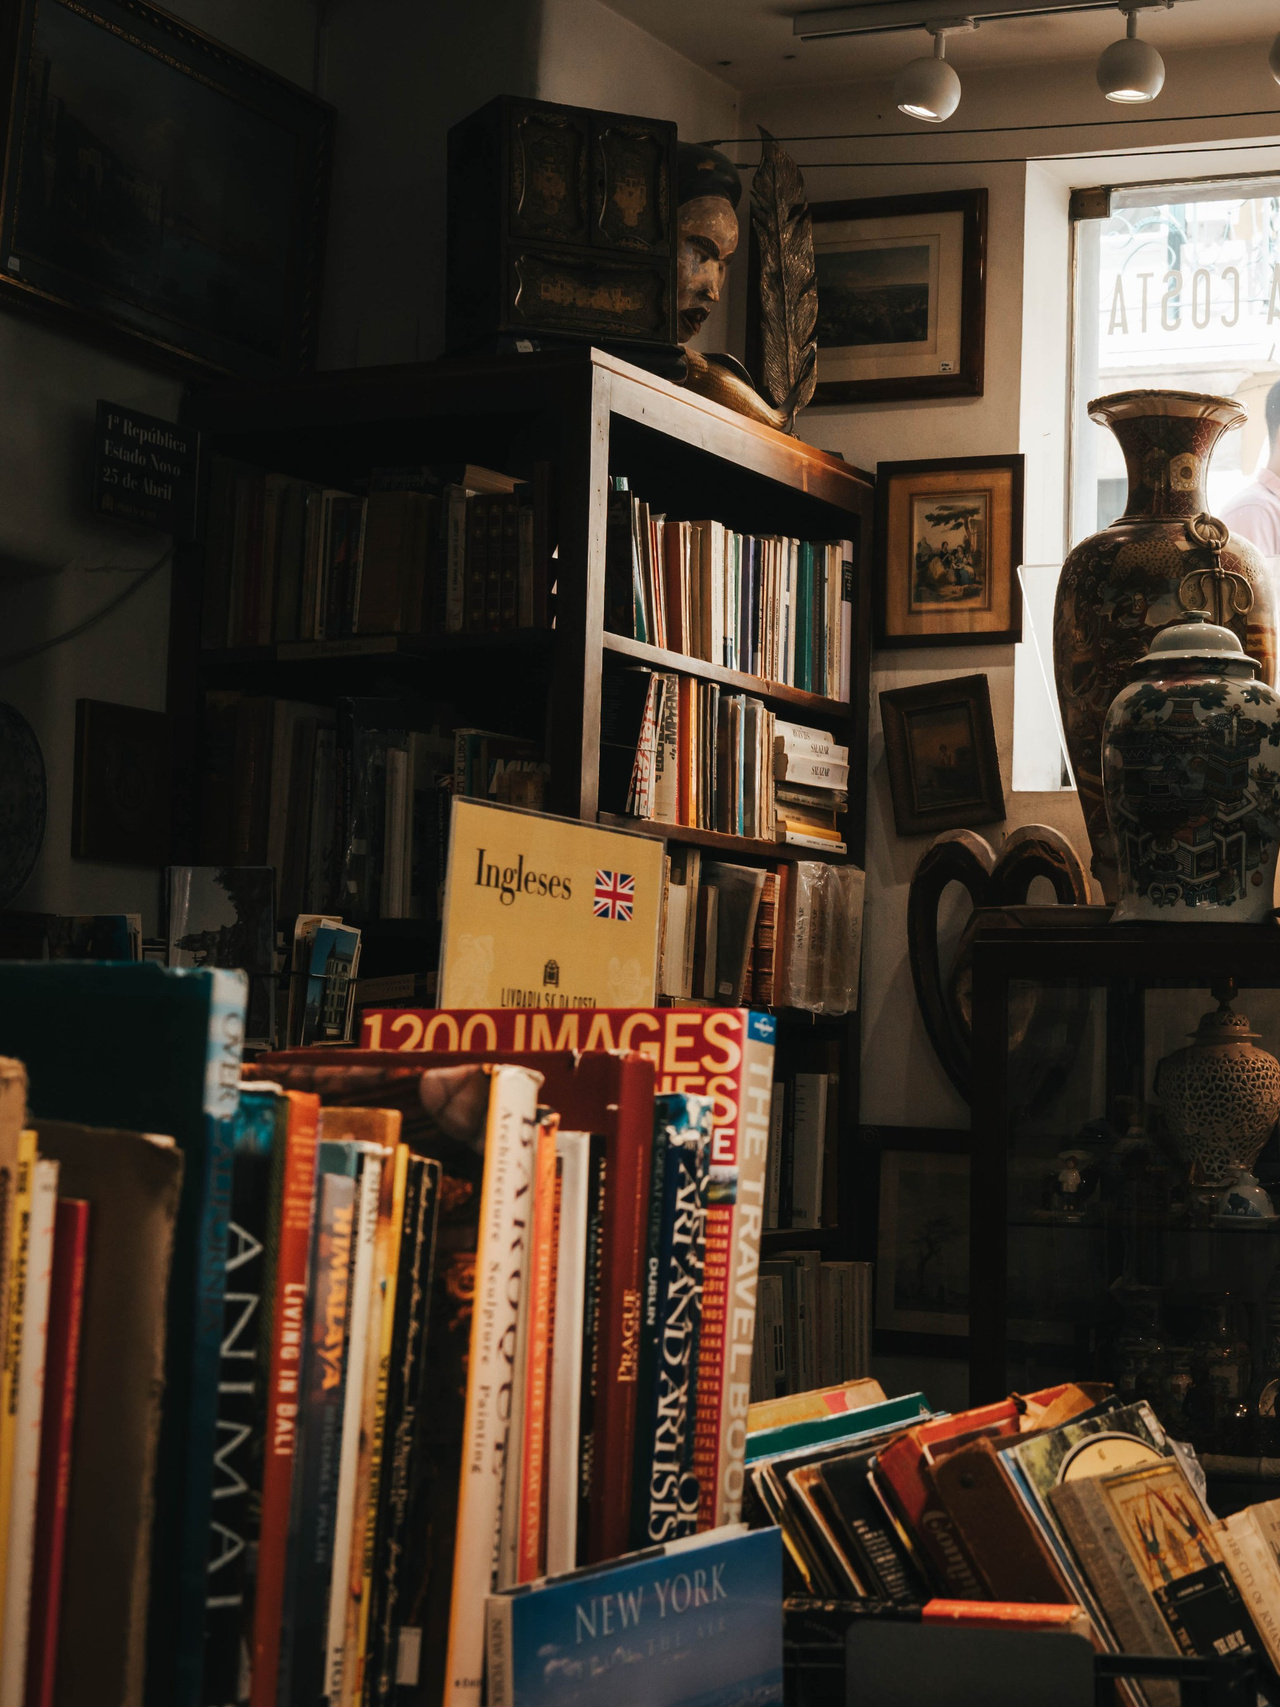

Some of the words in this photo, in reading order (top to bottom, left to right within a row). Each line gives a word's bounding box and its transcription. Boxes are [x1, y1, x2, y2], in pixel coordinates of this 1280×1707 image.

[104, 438, 147, 467] Estado
[150, 452, 182, 478] Novo
[123, 418, 188, 454] República
[102, 465, 118, 485] 25
[122, 473, 138, 492] de
[142, 480, 173, 501] Abril
[811, 743, 829, 755] SALAZAR
[811, 766, 830, 777] SALAZAR
[474, 847, 572, 906] Ingleses
[217, 1012, 243, 1102] OVER
[363, 1012, 498, 1050] 1200
[513, 1011, 743, 1074] IMAGES
[743, 1052, 773, 1157] THE
[489, 1108, 514, 1243] Architecture
[667, 1161, 697, 1247] ART
[201, 1116, 236, 1336] CALIFORNIA
[321, 1203, 354, 1391] HIMALAYA
[476, 1261, 502, 1366] Sculpture
[532, 1241, 551, 1334] THRACE
[646, 1257, 660, 1325] DUBLIN
[663, 1256, 690, 1367] AND
[731, 1175, 765, 1375] TRAVEL
[279, 1283, 302, 1360] LIVING
[531, 1336, 546, 1357] &
[616, 1289, 637, 1382] PRAGUE
[277, 1369, 297, 1394] IN
[529, 1364, 546, 1413] THE
[273, 1402, 296, 1456] BALI
[317, 1405, 337, 1494] MICHAEL
[470, 1384, 492, 1475] Painting
[650, 1370, 684, 1542] ARTISTS
[524, 1418, 545, 1559] THRACIANS
[315, 1504, 333, 1563] PALIN
[1225, 1536, 1241, 1560] THE
[1236, 1560, 1255, 1587] CITY
[1251, 1590, 1265, 1606] OF
[575, 1586, 644, 1645] NEW
[653, 1562, 728, 1619] YORK
